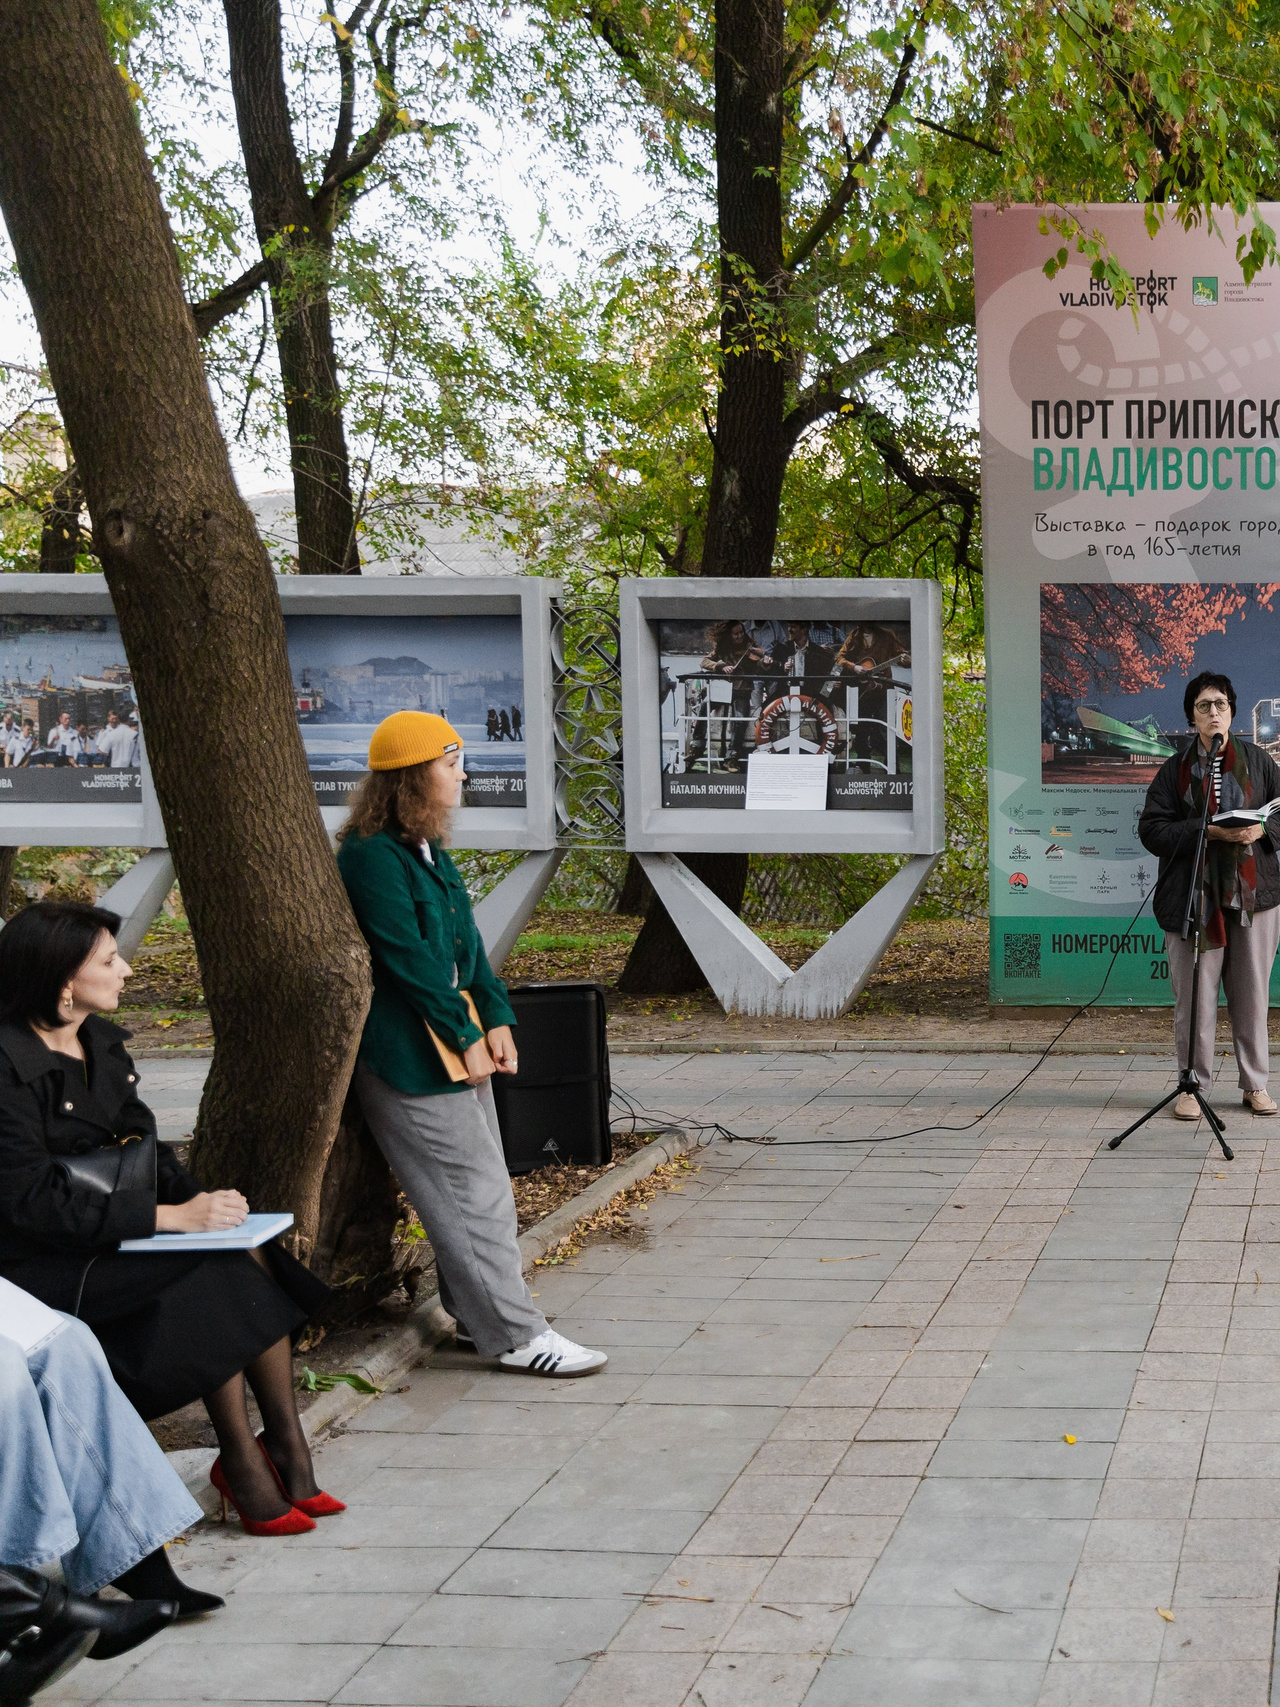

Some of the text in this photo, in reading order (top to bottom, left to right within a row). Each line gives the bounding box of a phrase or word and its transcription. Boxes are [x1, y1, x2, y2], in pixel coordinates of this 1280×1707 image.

[1089, 277, 1177, 291] HOPORT
[1224, 281, 1272, 289] Админитрация
[1031, 399, 1114, 440] ПОРТ
[1034, 512, 1127, 533] Выставка
[1154, 518, 1232, 538] подарок
[1087, 536, 1242, 560] в год 165-летия
[312, 781, 336, 791] СЛАВ
[670, 784, 746, 795] НАТАЛЬЯ ЯКУНИНА
[1004, 969, 1042, 979] ВКОНТАКТЕ
